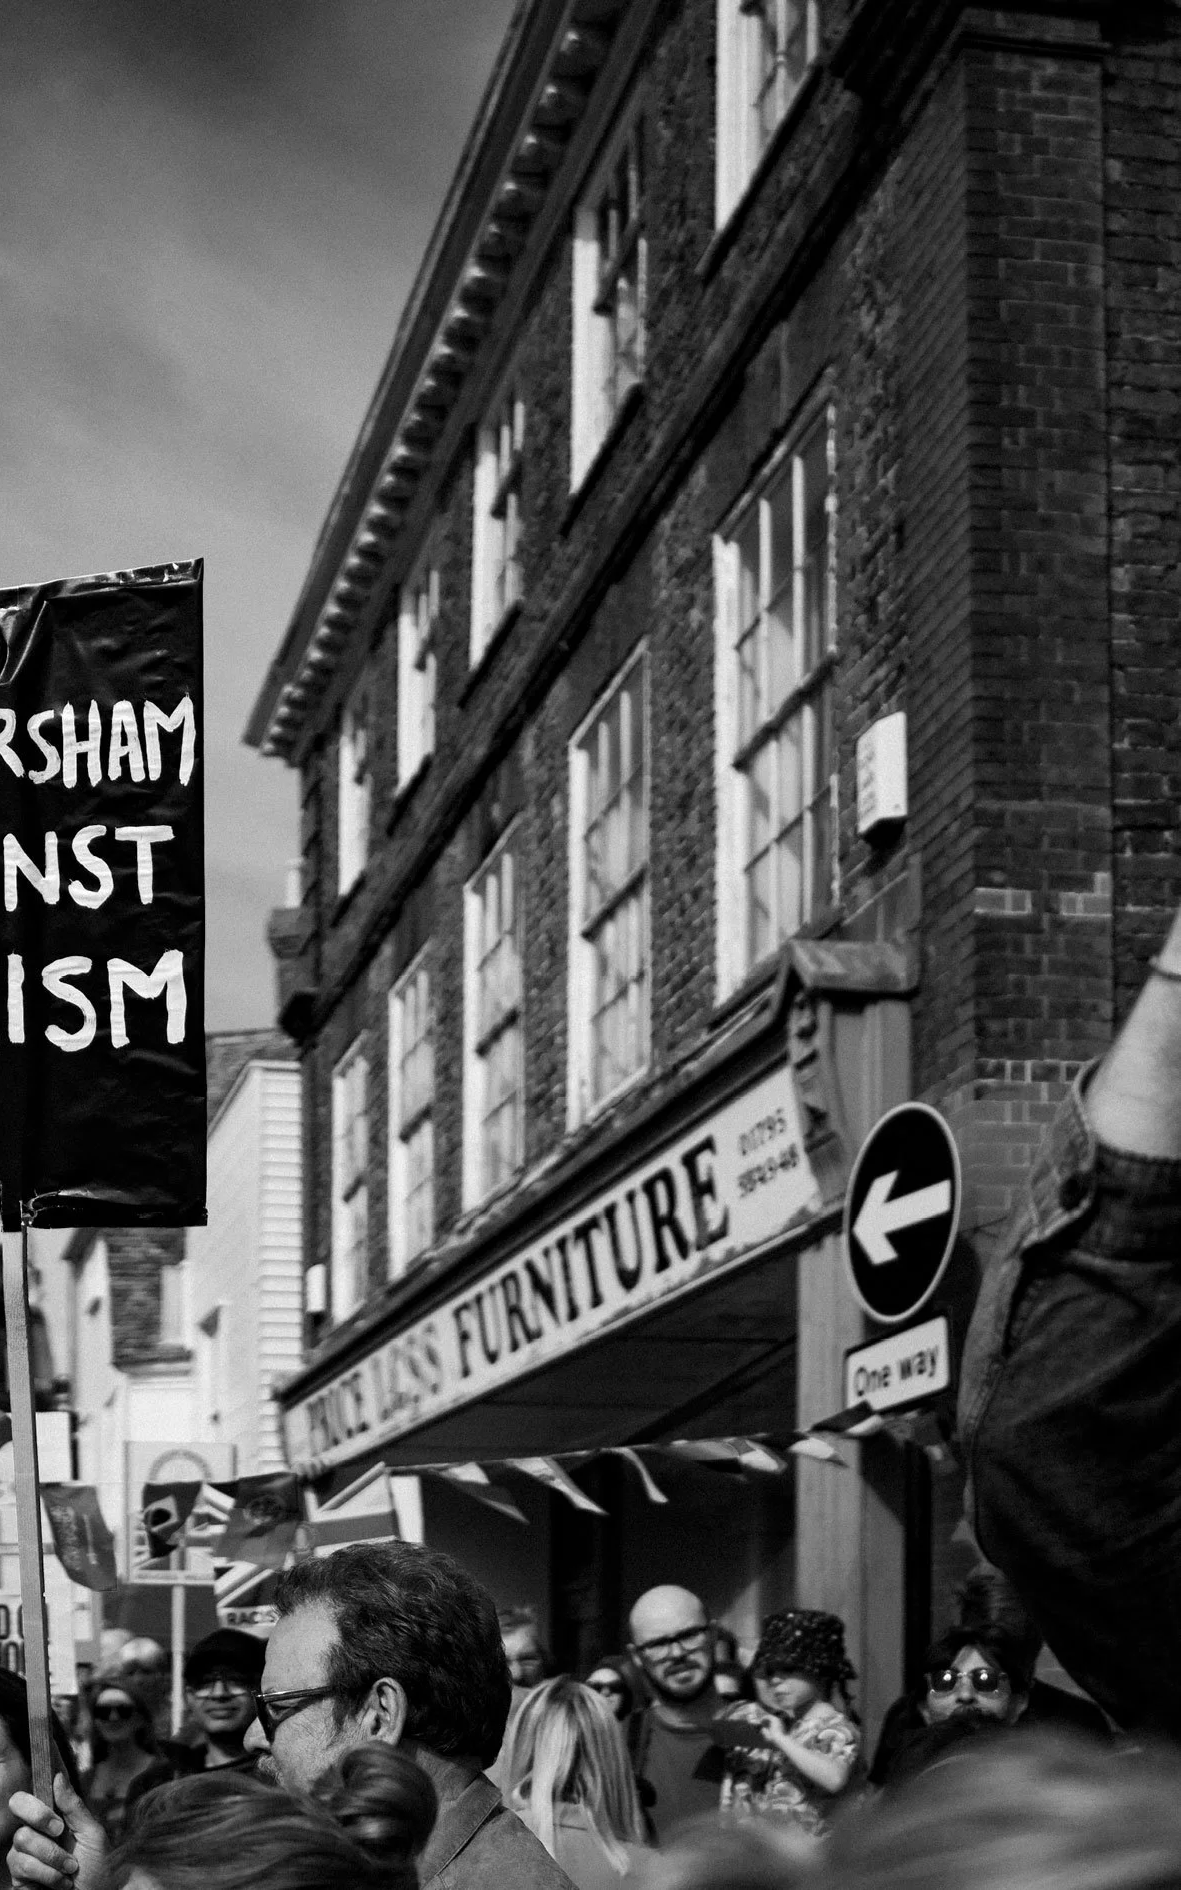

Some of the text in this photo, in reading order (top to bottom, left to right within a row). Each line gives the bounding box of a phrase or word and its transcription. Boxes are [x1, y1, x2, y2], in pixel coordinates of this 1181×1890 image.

[451, 1134, 729, 1379] FURNITURE
[854, 1345, 938, 1397] One way
